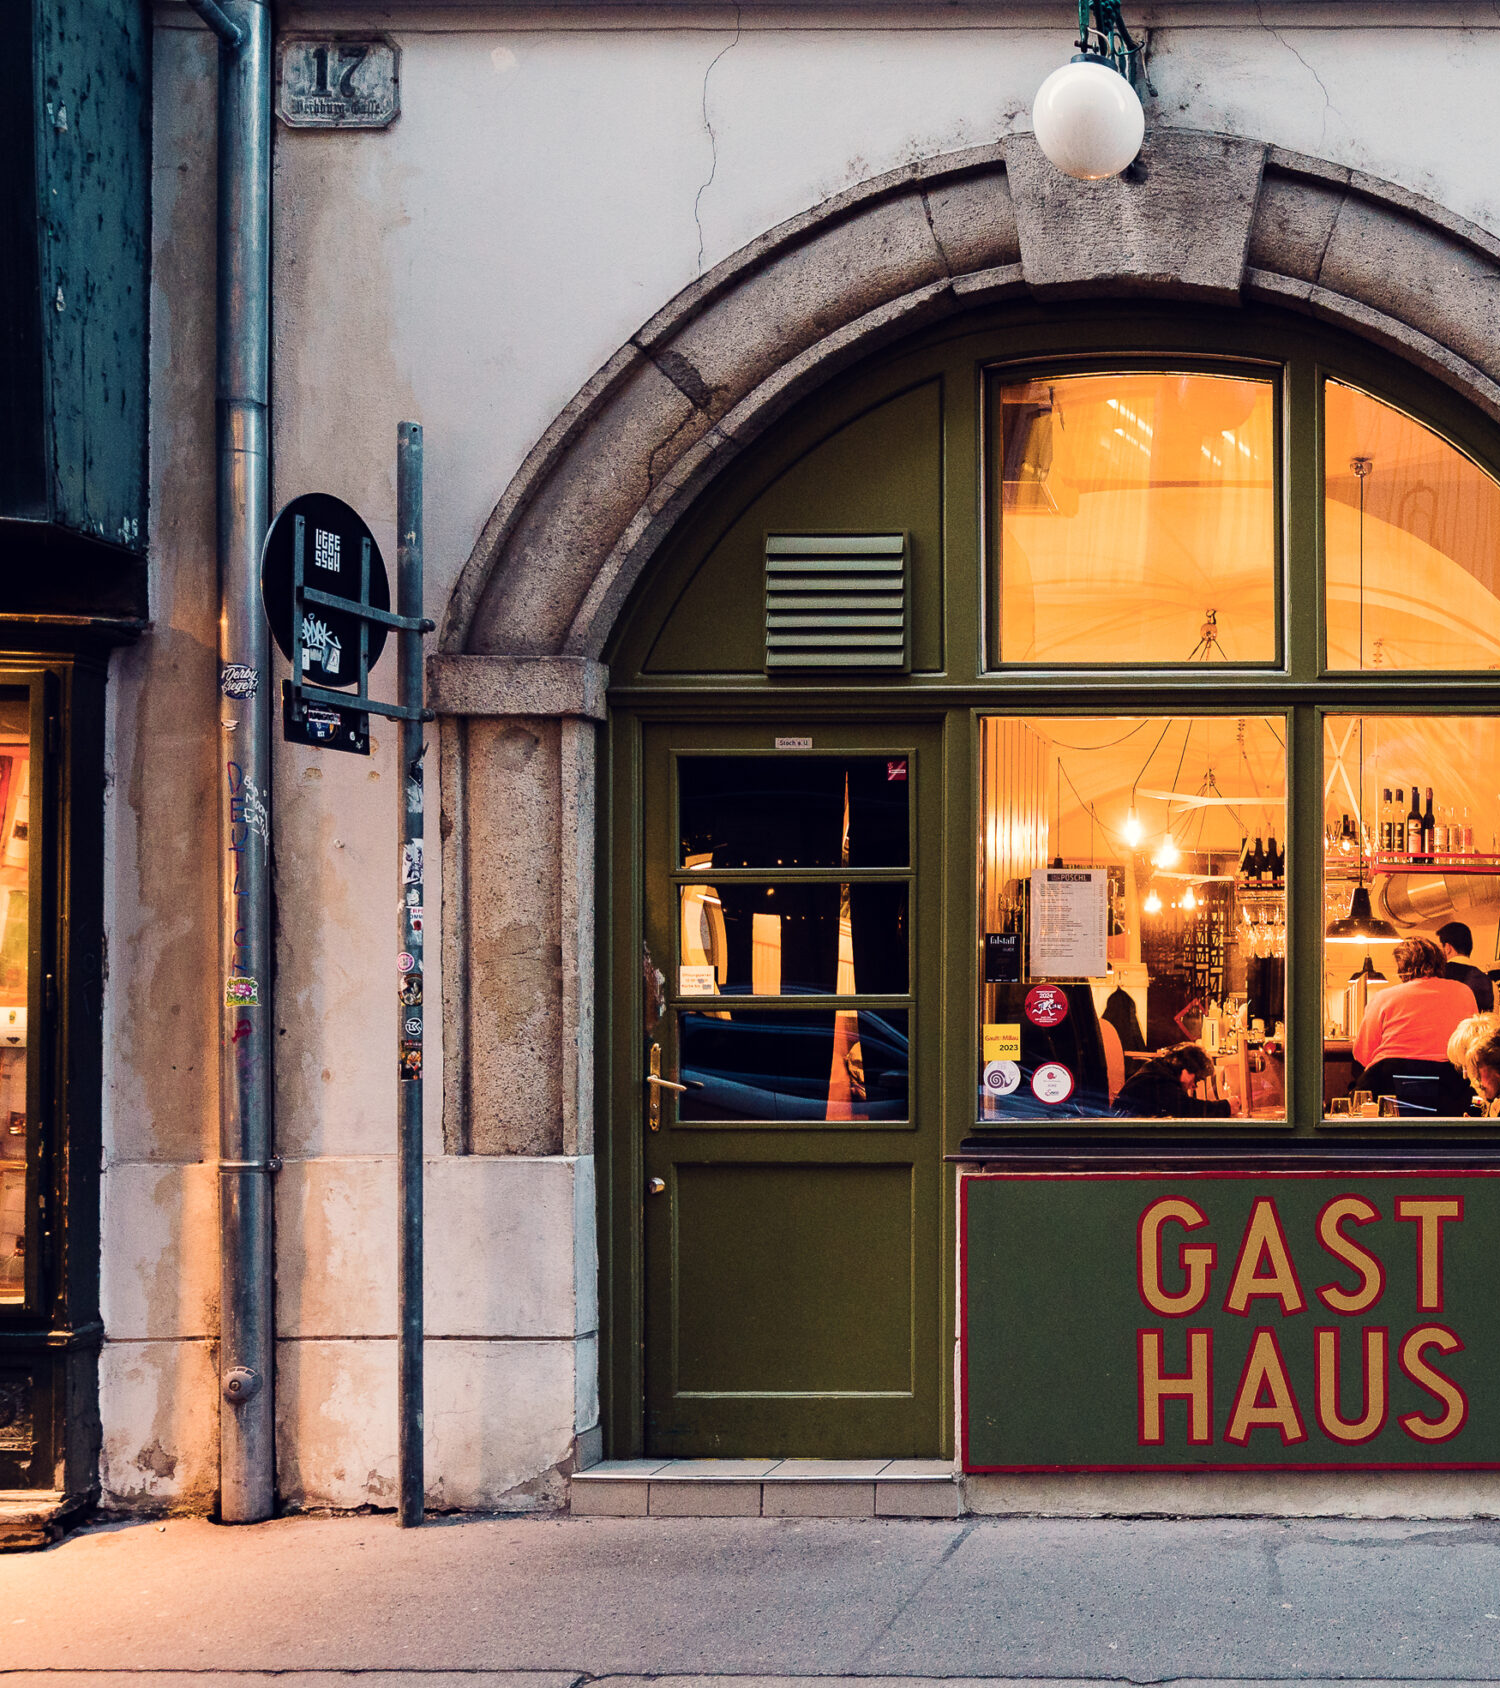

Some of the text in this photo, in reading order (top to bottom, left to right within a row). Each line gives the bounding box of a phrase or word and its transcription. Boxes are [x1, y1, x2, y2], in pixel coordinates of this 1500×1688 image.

[312, 45, 369, 97] 17
[222, 668, 257, 681] Derby
[990, 936, 1016, 944] falstaff
[1136, 1194, 1464, 1319] GAST
[1136, 1322, 1468, 1447] HAUS
